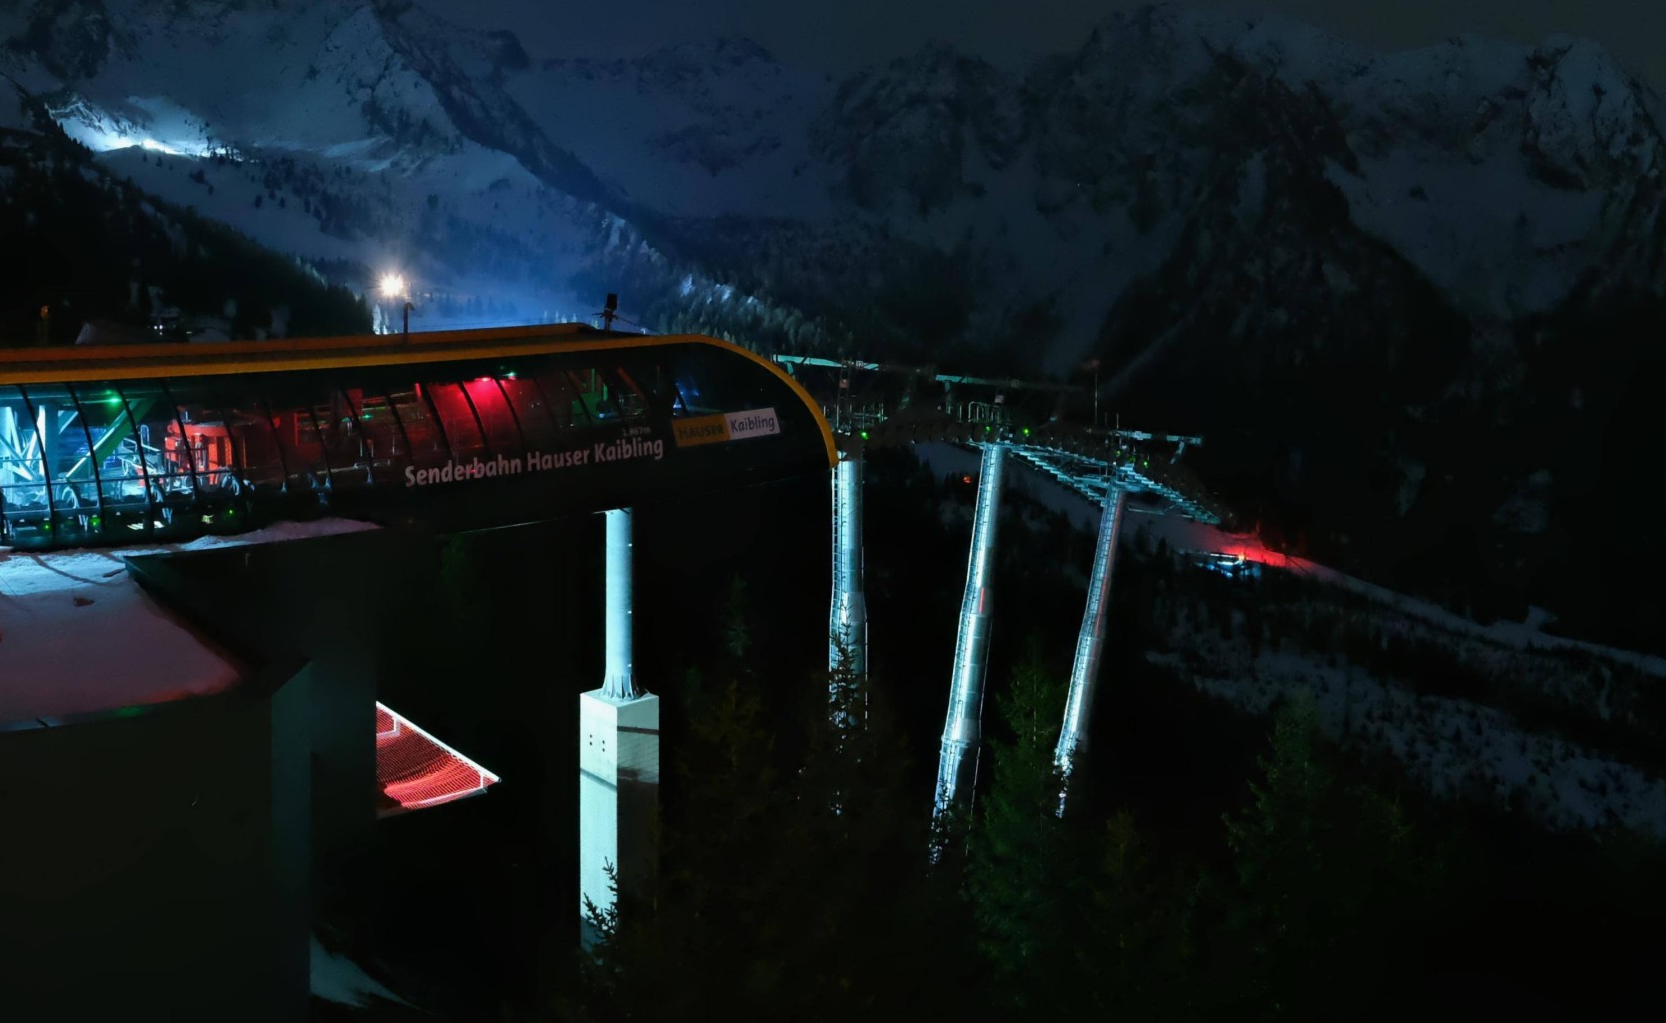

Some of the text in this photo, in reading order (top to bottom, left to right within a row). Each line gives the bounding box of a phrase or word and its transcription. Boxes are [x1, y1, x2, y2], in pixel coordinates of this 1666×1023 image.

[730, 415, 775, 433] Kaibling
[405, 438, 663, 487] Senderbahn Hauser Kaibling
